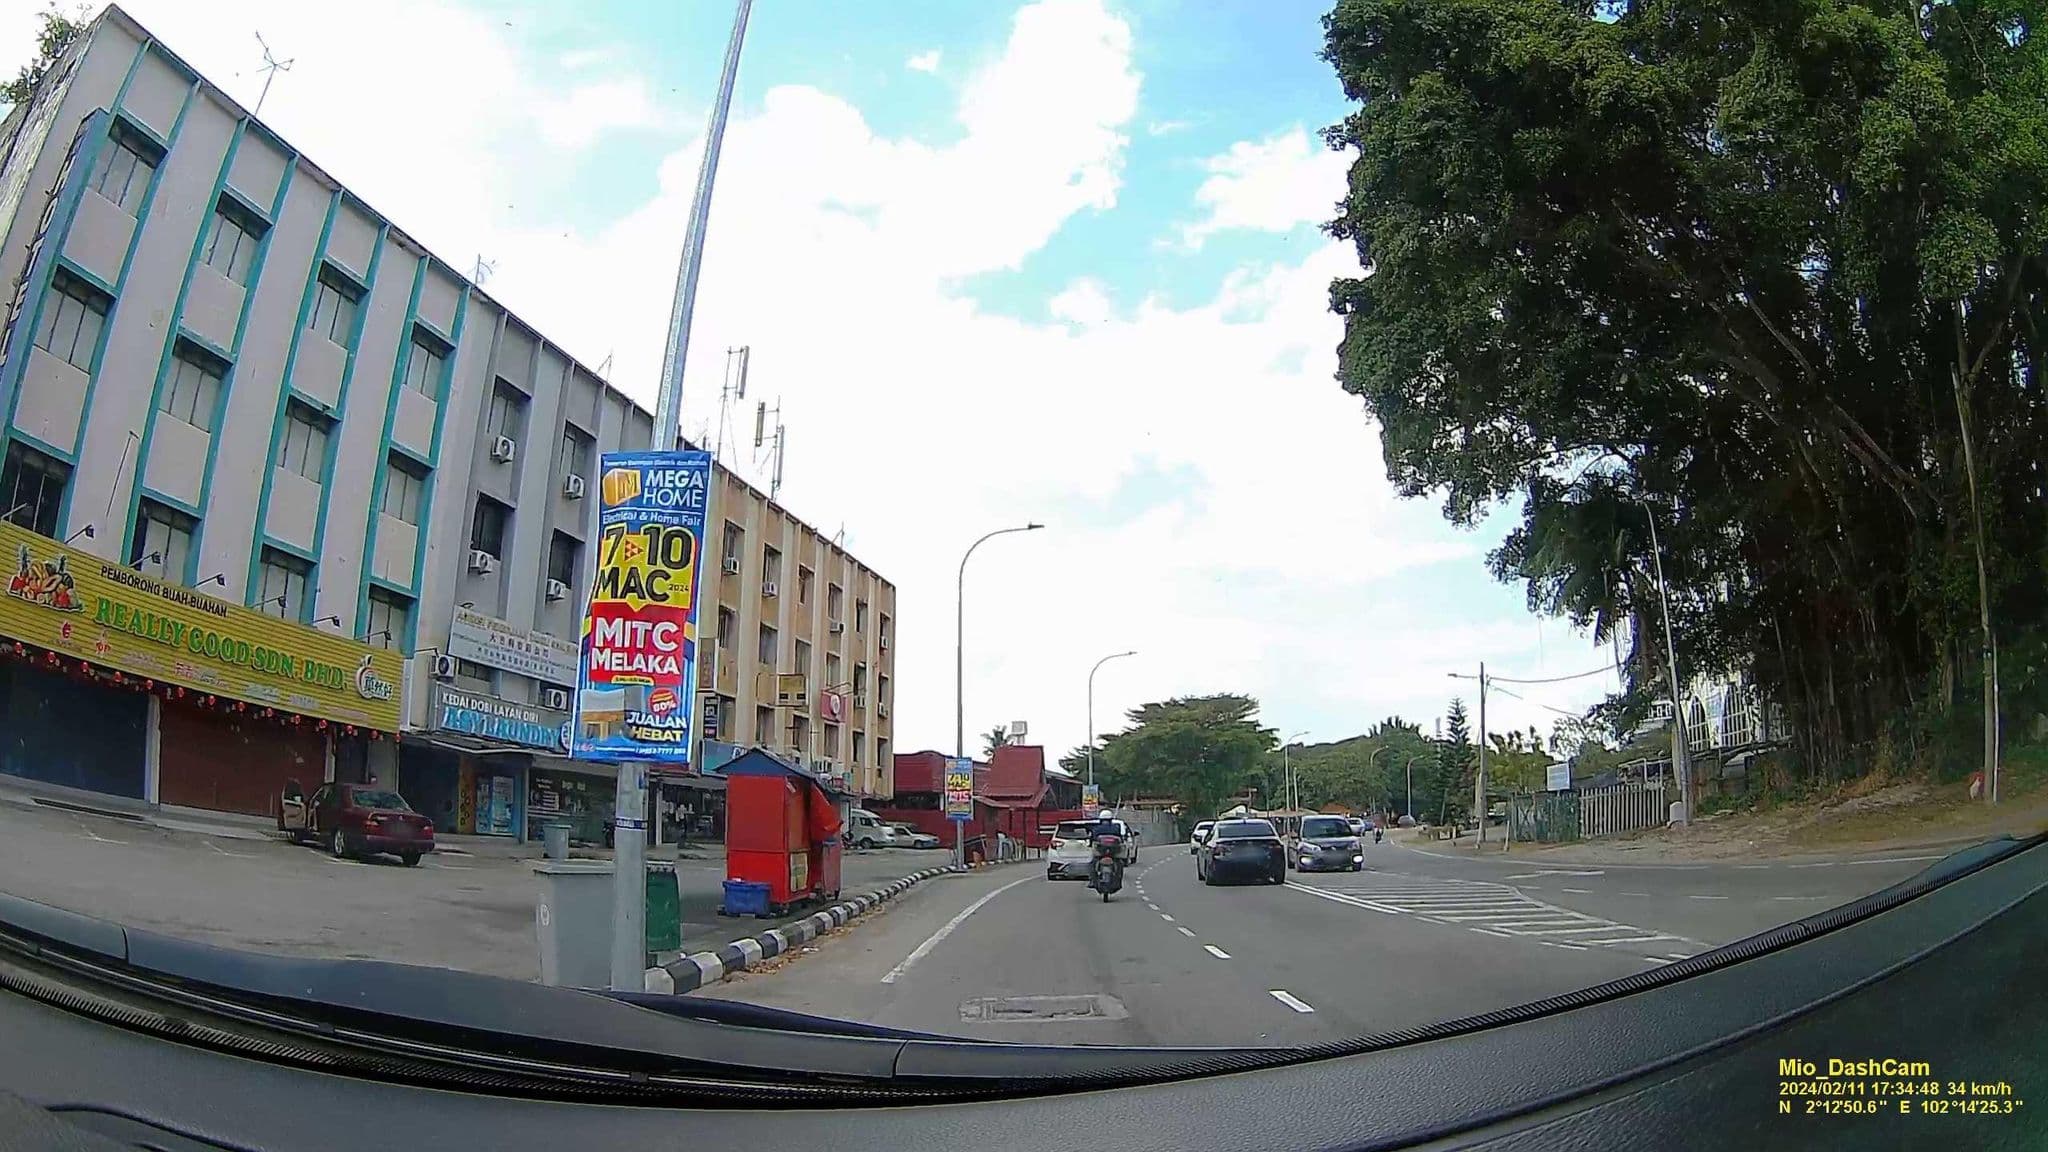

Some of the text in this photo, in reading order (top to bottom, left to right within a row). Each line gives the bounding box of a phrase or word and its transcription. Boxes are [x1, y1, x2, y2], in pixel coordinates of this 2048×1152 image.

[645, 469, 704, 489] MEGA
[642, 487, 704, 508] HOME
[602, 511, 702, 526] Electrical & Home Fair
[604, 525, 694, 570] 7 10
[101, 565, 228, 618] PEMBORONG BUAH-BUAHAN
[595, 566, 689, 602] MAC 2024
[94, 596, 187, 649] REALLY
[188, 625, 251, 667] GOOD
[595, 616, 679, 652] MITC
[591, 647, 681, 675] MELAKA
[442, 691, 540, 724] KEDAI DOBI LAYAN DIRI
[626, 711, 688, 729] JUALAN
[631, 726, 684, 743] HEBAT
